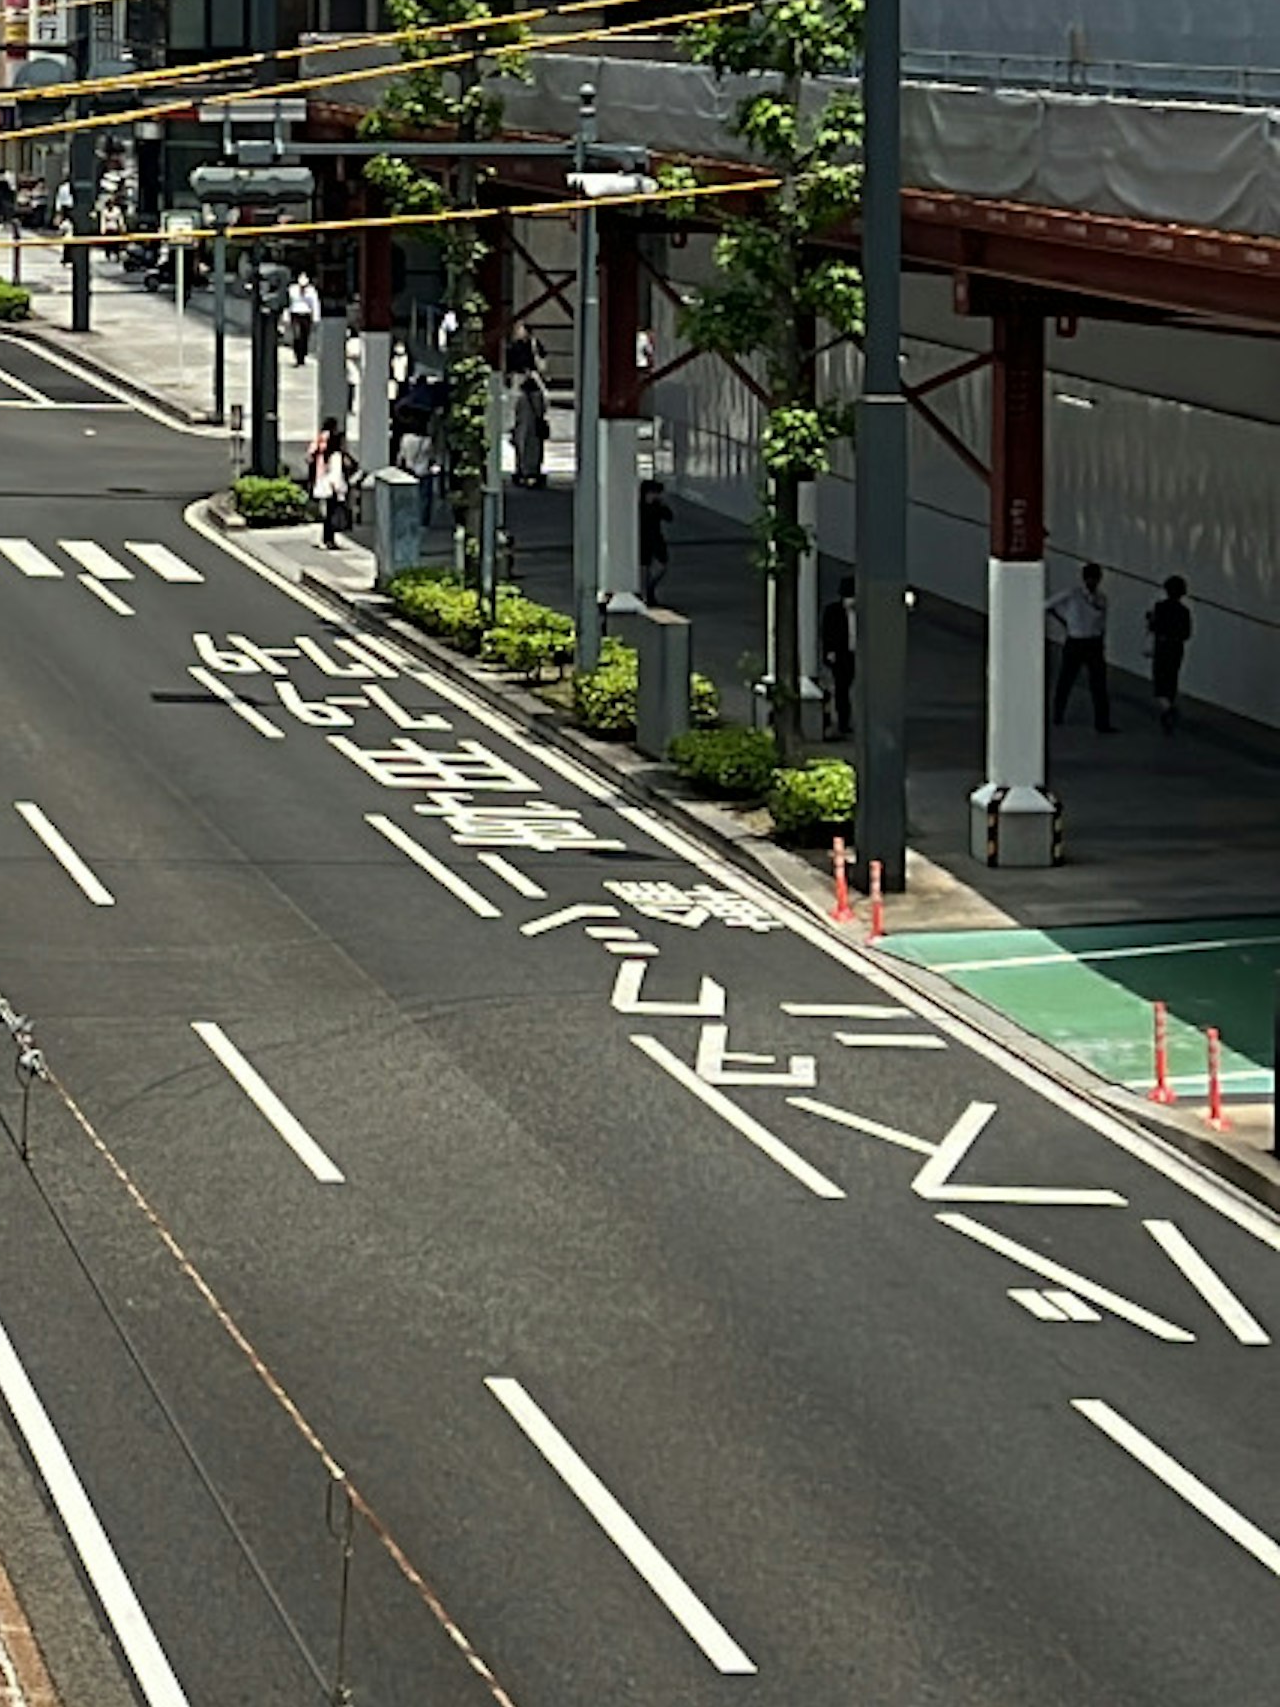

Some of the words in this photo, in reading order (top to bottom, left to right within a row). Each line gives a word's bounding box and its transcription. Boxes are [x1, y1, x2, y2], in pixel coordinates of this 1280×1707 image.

[192, 632, 401, 677] 17-19
[274, 680, 454, 731] 7-9
[326, 734, 628, 852] 専用
[477, 852, 817, 1087] タクシー
[785, 1095, 1270, 1346] バス
